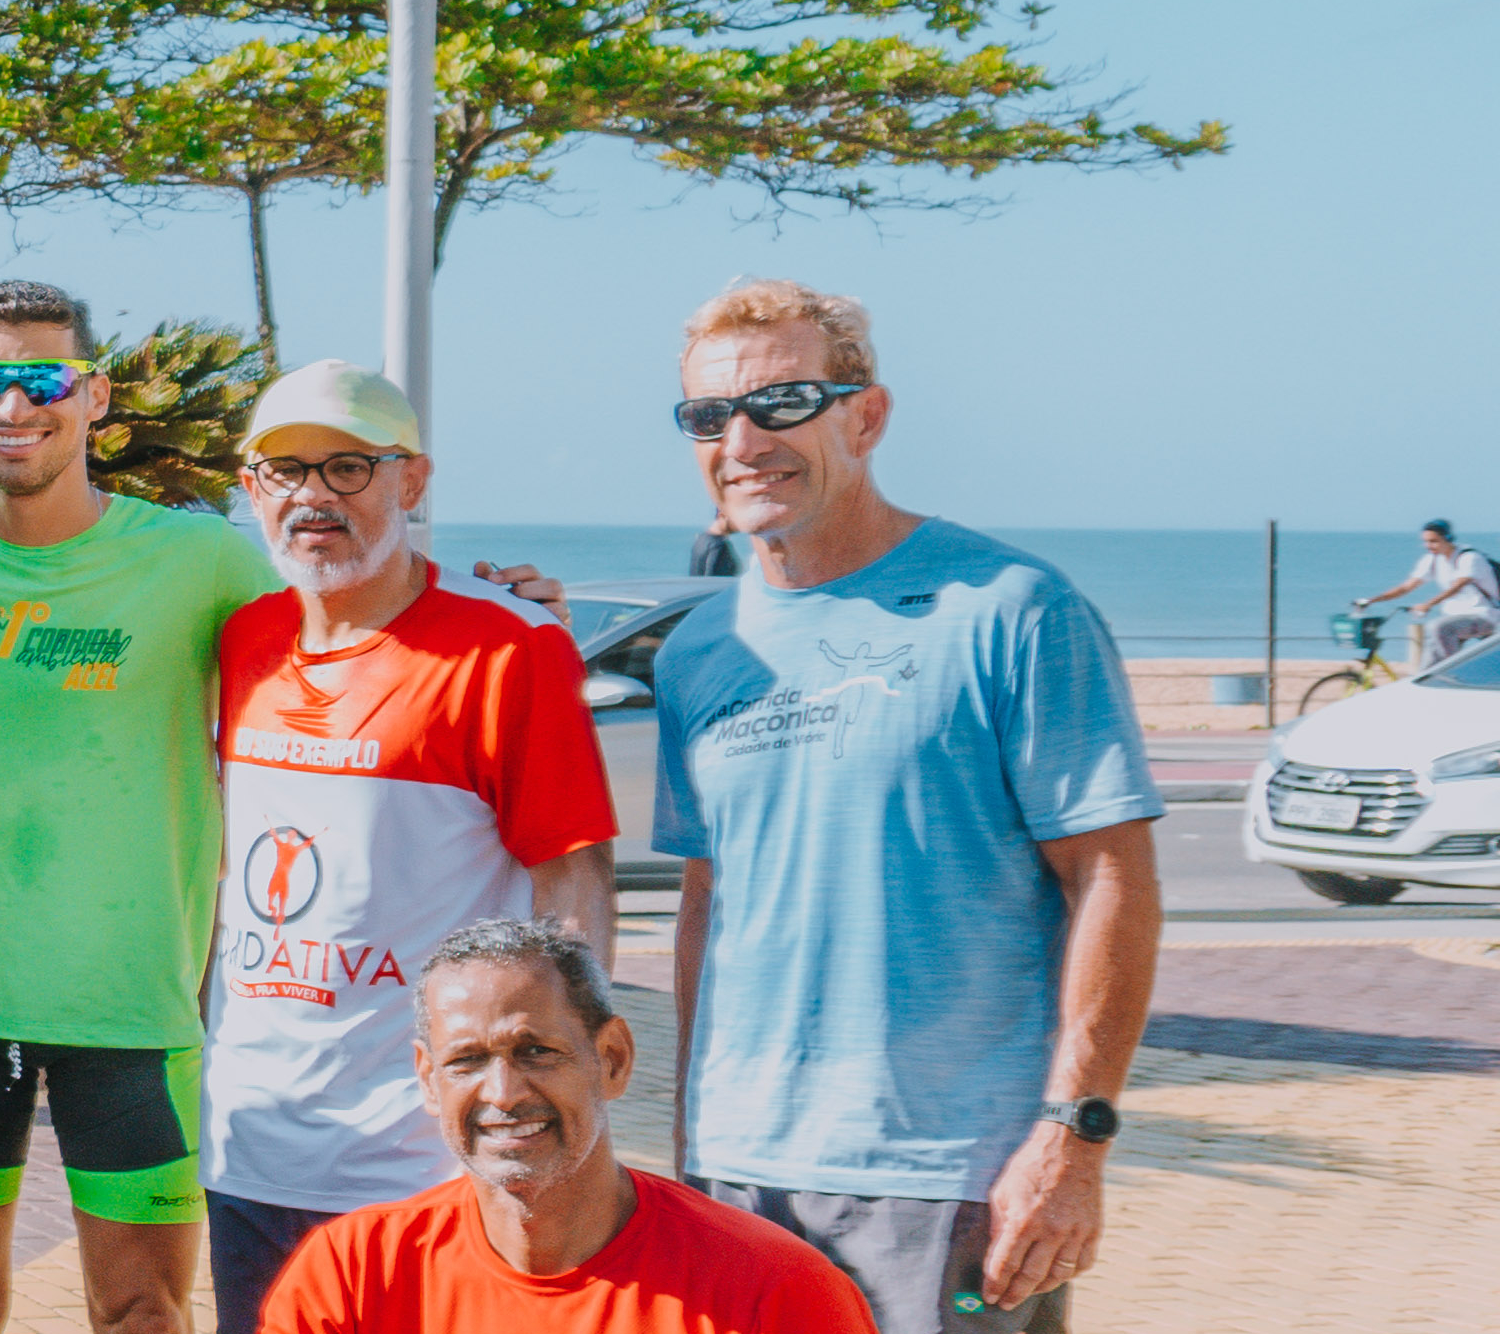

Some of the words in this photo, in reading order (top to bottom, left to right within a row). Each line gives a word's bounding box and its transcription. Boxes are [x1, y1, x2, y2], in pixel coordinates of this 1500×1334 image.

[25, 628, 123, 655] CORRIDA
[729, 687, 802, 717] Corrida
[715, 701, 839, 745] Maçônica
[289, 734, 380, 770] EXEMPLO
